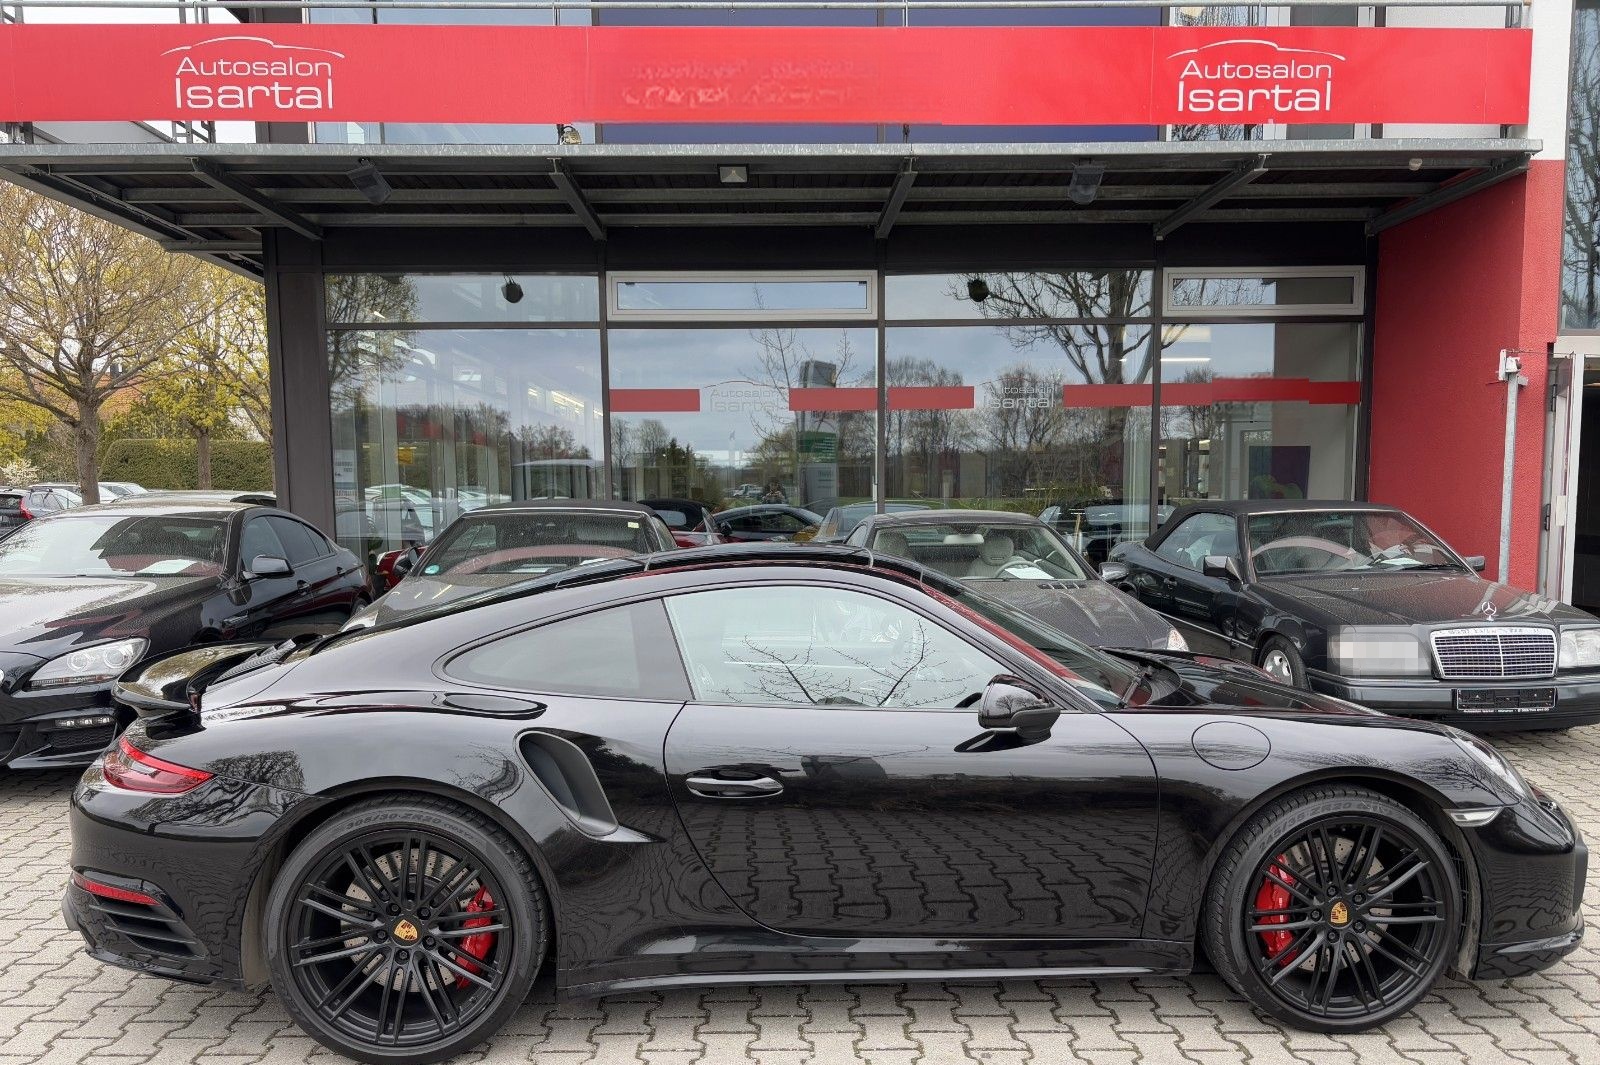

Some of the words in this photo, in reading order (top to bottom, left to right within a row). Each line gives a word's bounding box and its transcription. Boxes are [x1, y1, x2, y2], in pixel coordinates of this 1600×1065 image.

[175, 56, 332, 77] Autosalon
[1180, 59, 1332, 79] Autosalon
[175, 77, 333, 109] Isartal
[1177, 80, 1332, 112] Isartal
